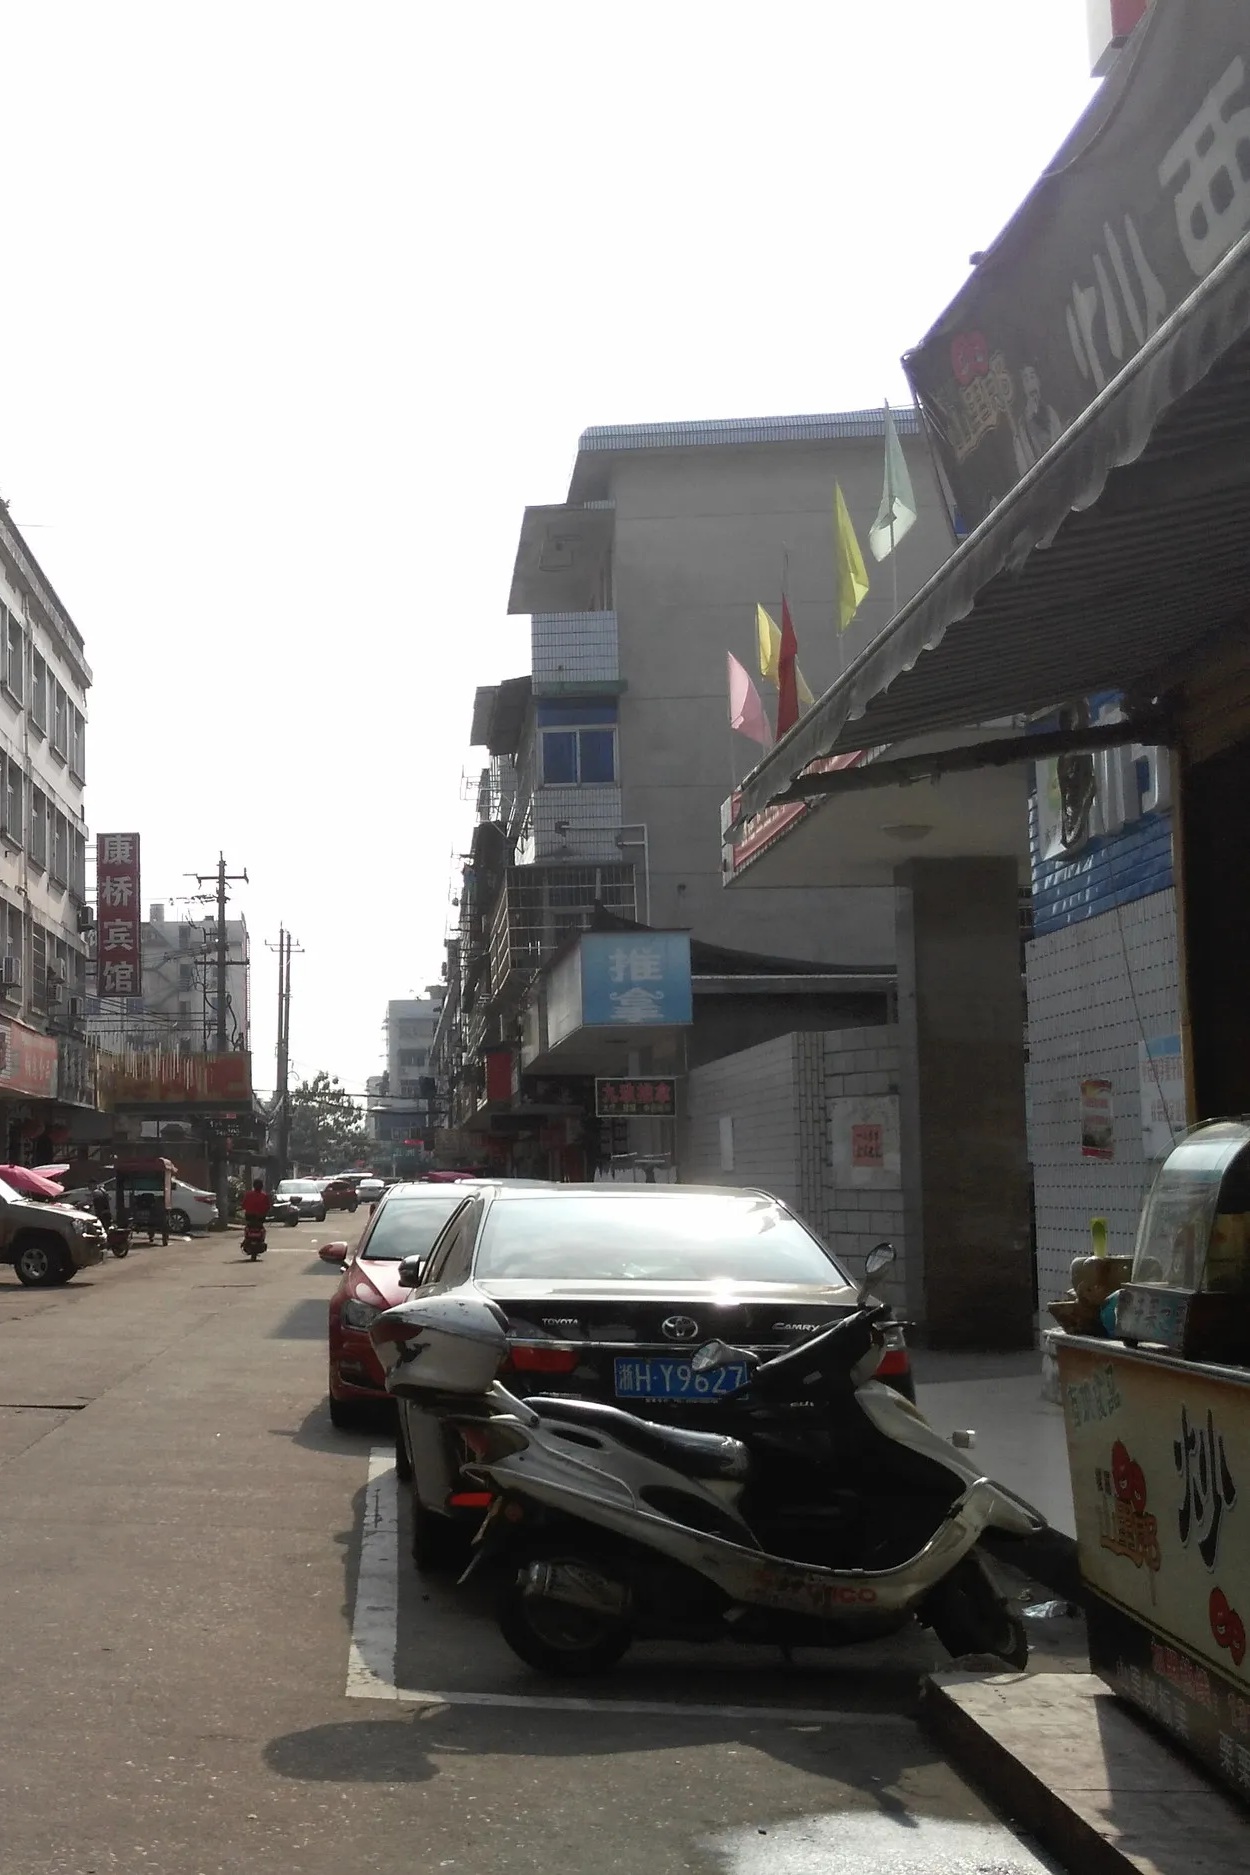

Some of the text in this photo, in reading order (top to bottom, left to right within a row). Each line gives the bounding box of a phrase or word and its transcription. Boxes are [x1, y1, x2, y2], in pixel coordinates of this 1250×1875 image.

[102, 834, 134, 993] 康桥宾馆
[609, 947, 664, 1022] 推拿
[542, 1317, 579, 1327] TOYOTA
[772, 1322, 821, 1331] CAMRY
[1174, 1403, 1236, 1568] 炒
